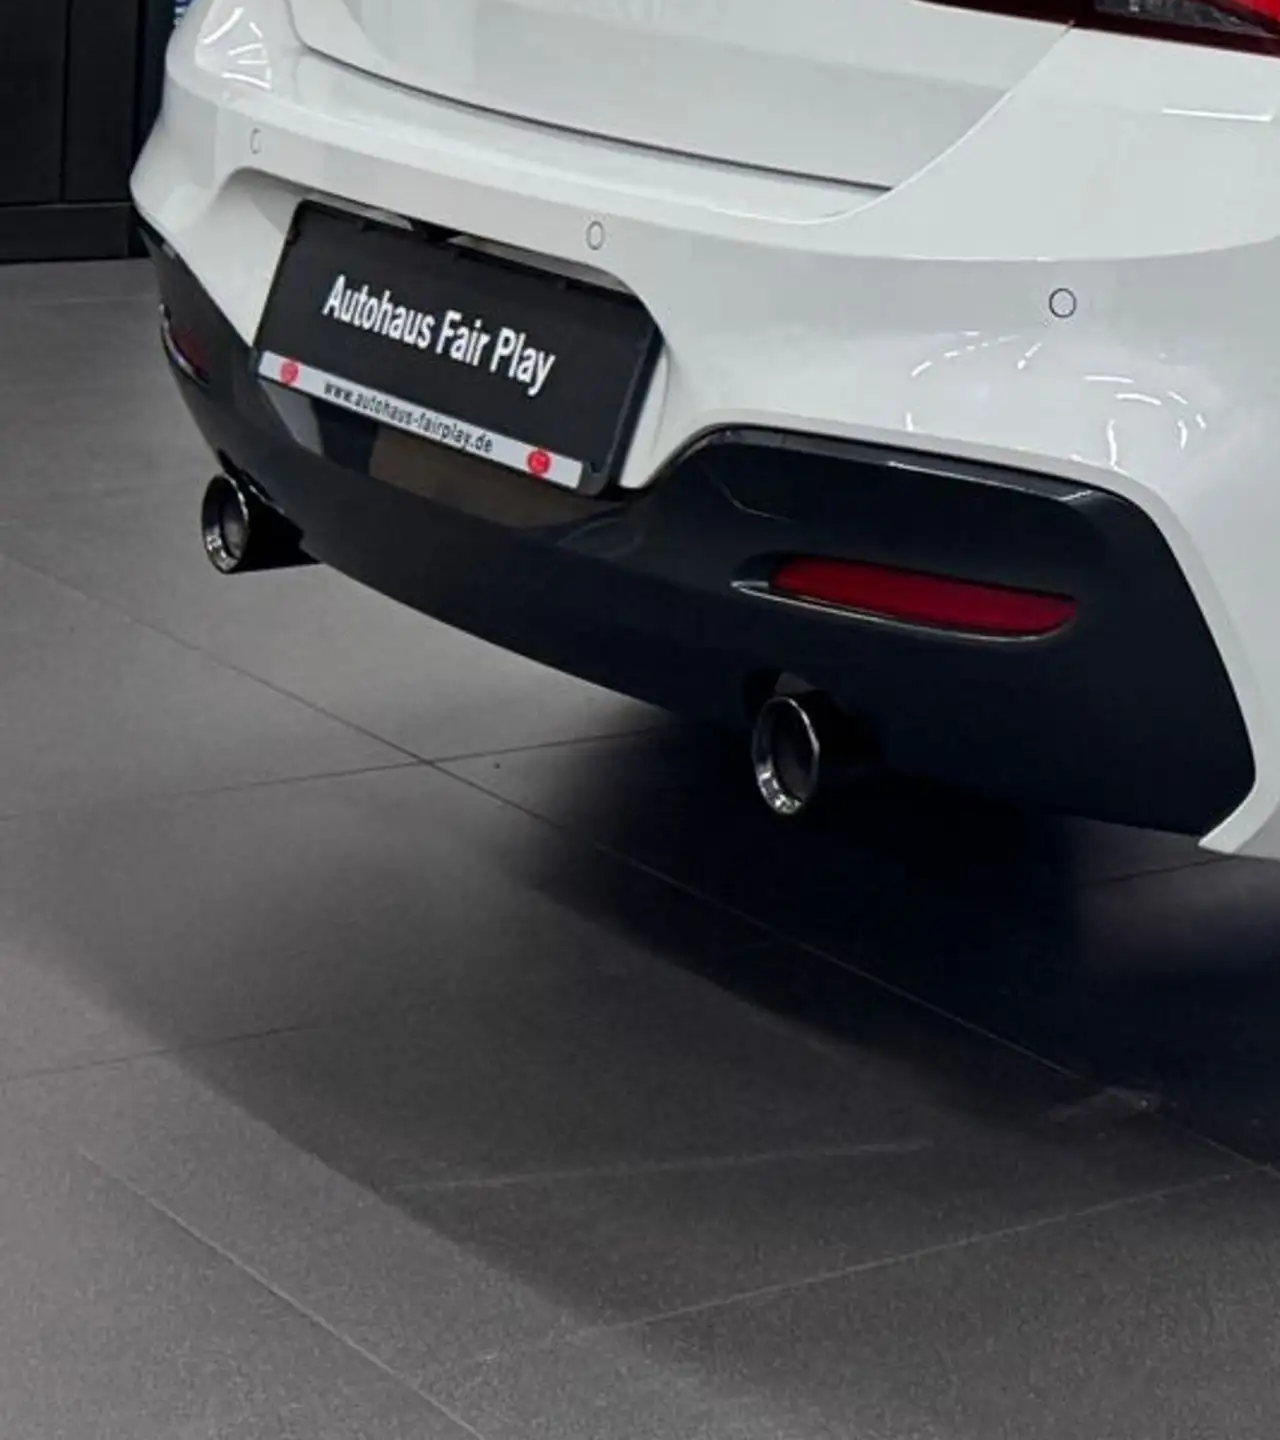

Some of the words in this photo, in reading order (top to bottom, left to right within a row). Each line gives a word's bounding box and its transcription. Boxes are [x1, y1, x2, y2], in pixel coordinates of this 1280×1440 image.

[322, 274, 436, 349] Autohaus
[435, 310, 491, 367] Fair
[489, 326, 556, 397] Play
[323, 381, 494, 454] www.autohaus-fairplay.de
